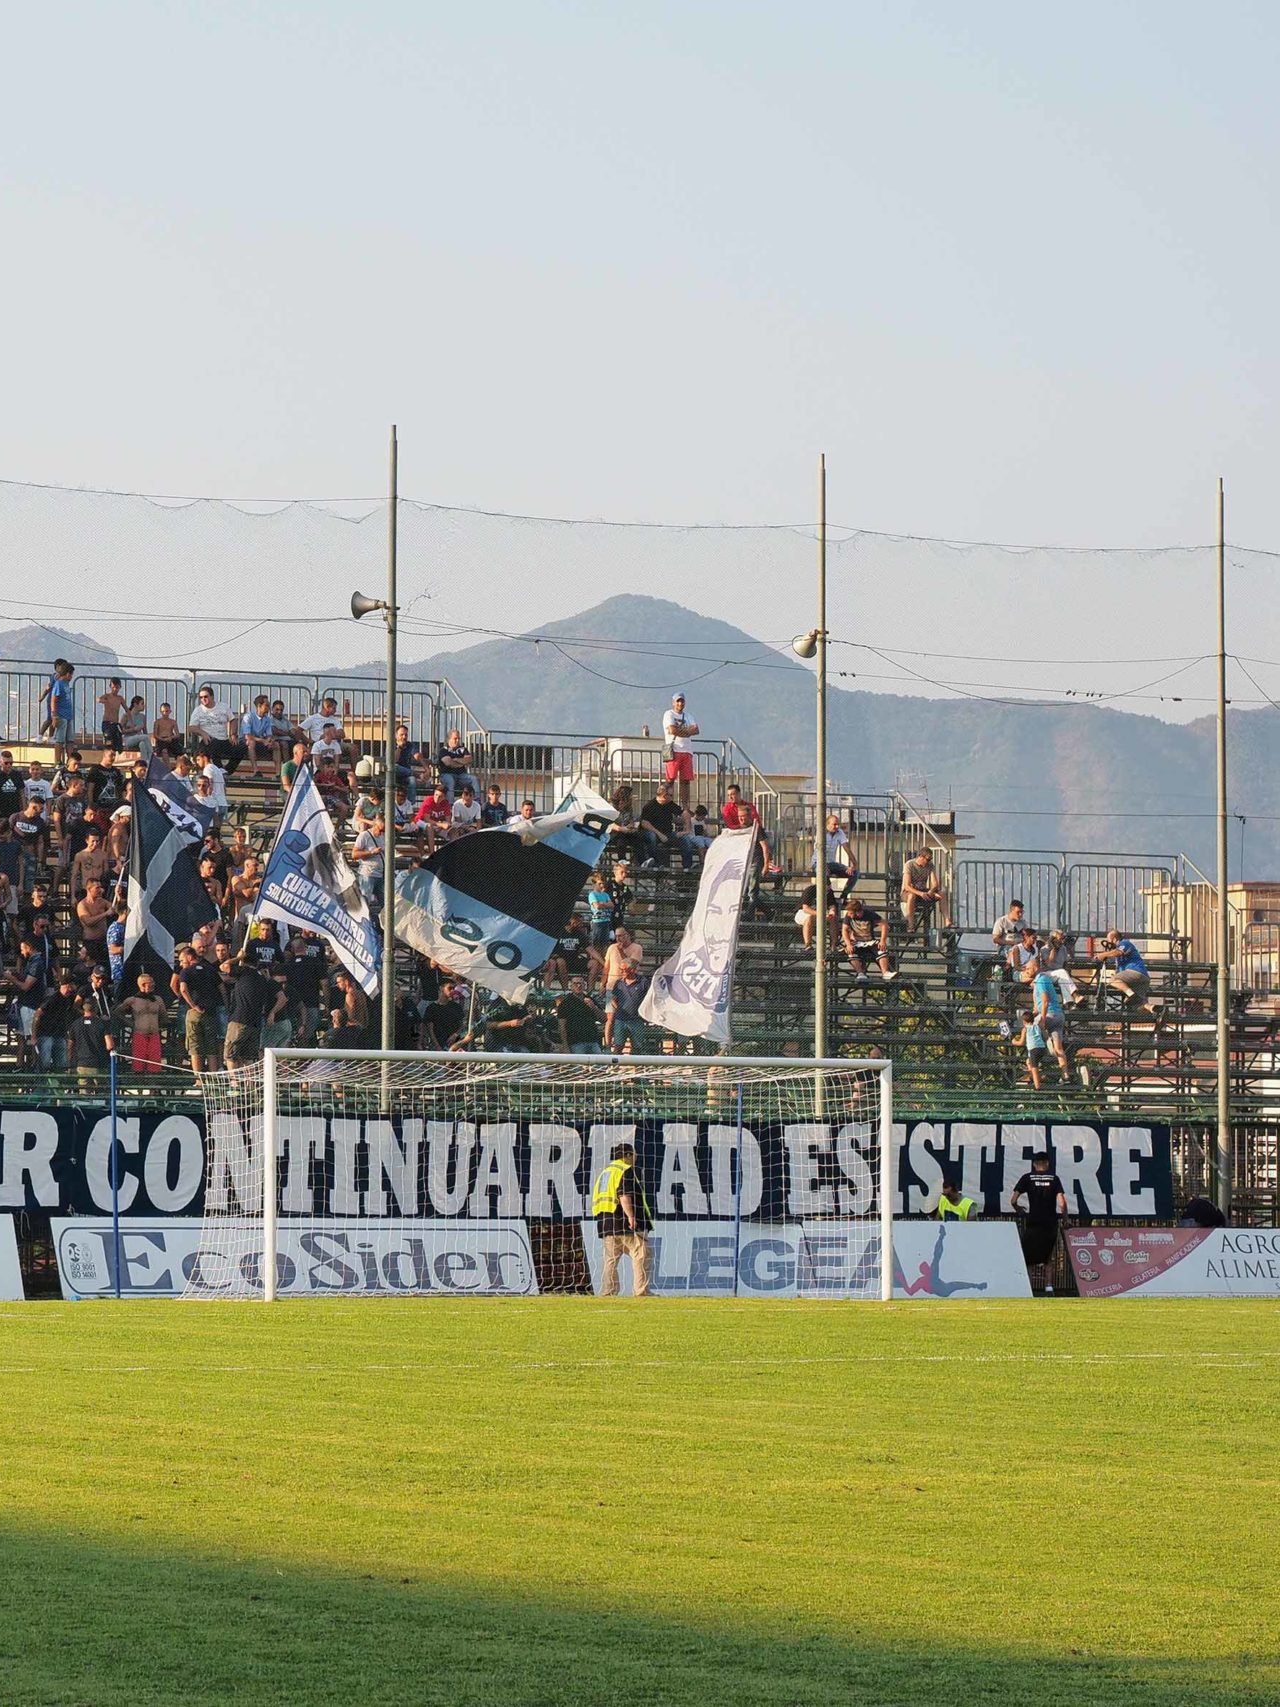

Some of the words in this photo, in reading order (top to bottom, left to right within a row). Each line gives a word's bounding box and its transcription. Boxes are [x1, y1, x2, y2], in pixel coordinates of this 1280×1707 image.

[282, 872, 332, 910] CURVA
[265, 882, 320, 918] SALVATORE
[319, 912, 375, 968] FRANCAVILLA
[656, 1123, 763, 1216] AD
[783, 1121, 1156, 1217] ESISTERE
[88, 1231, 522, 1293] EcoSider
[1165, 1236, 1202, 1266] PANIFICAZIONE
[1221, 1233, 1280, 1254] AGR
[647, 1236, 902, 1291] LEGEA
[1131, 1266, 1161, 1284] GELATERIA
[1086, 1283, 1124, 1297] PASTICCERIA
